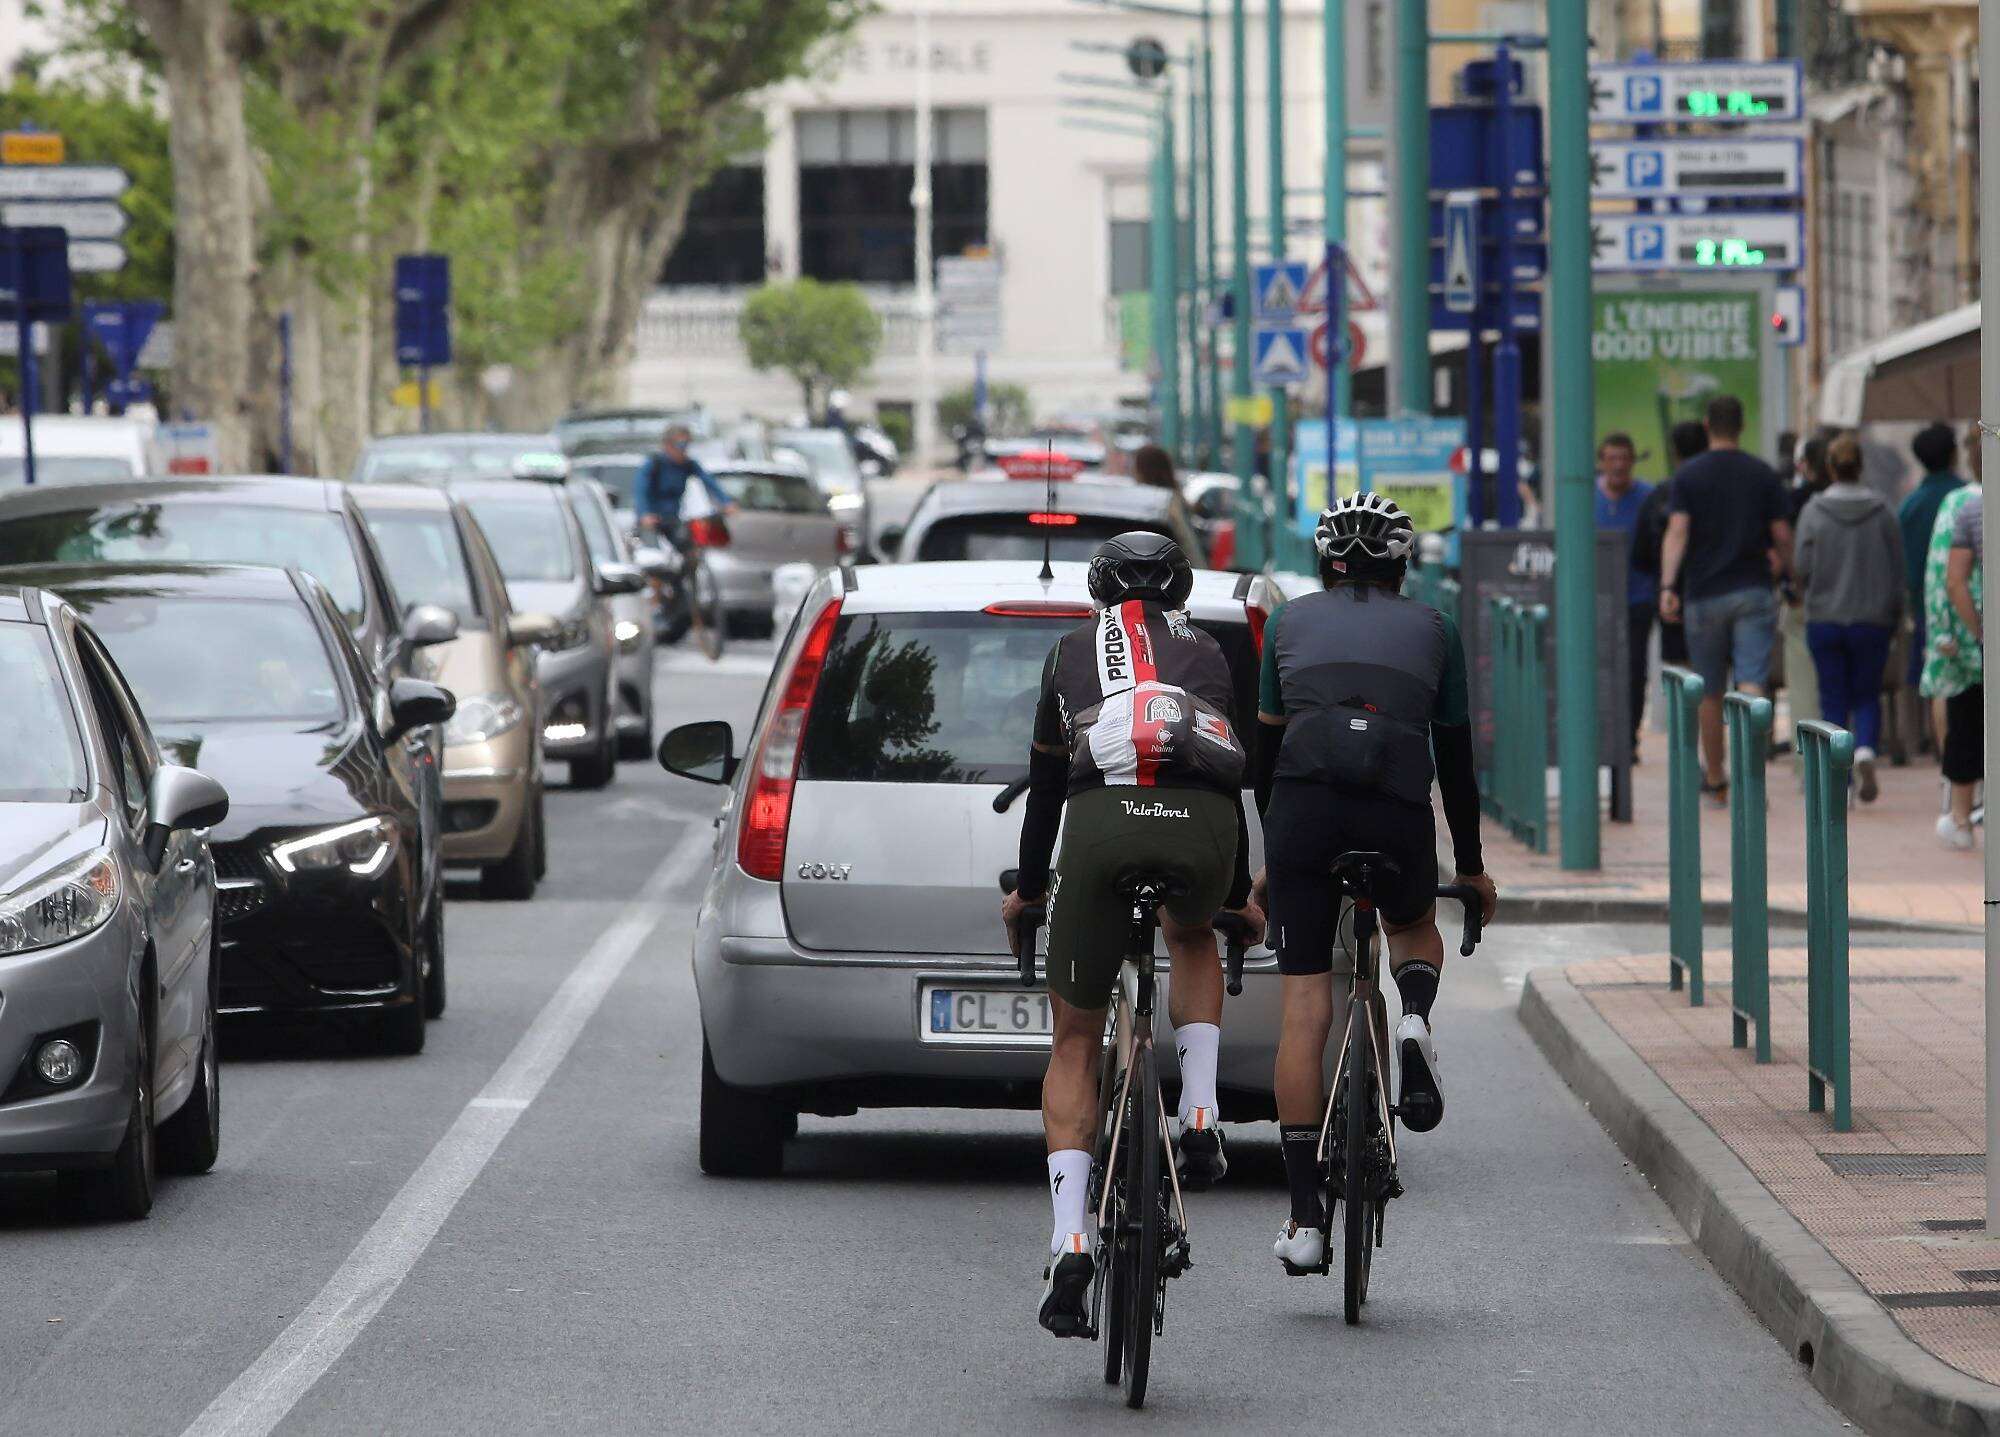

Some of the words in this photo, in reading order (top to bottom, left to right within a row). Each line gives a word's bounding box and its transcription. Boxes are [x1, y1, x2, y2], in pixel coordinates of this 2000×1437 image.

[1591, 333, 1653, 360] OOD
[1153, 710, 1179, 719] ROMA
[1151, 744, 1175, 753] Nalini
[798, 862, 852, 880] COLT
[956, 994, 998, 1030] CL
